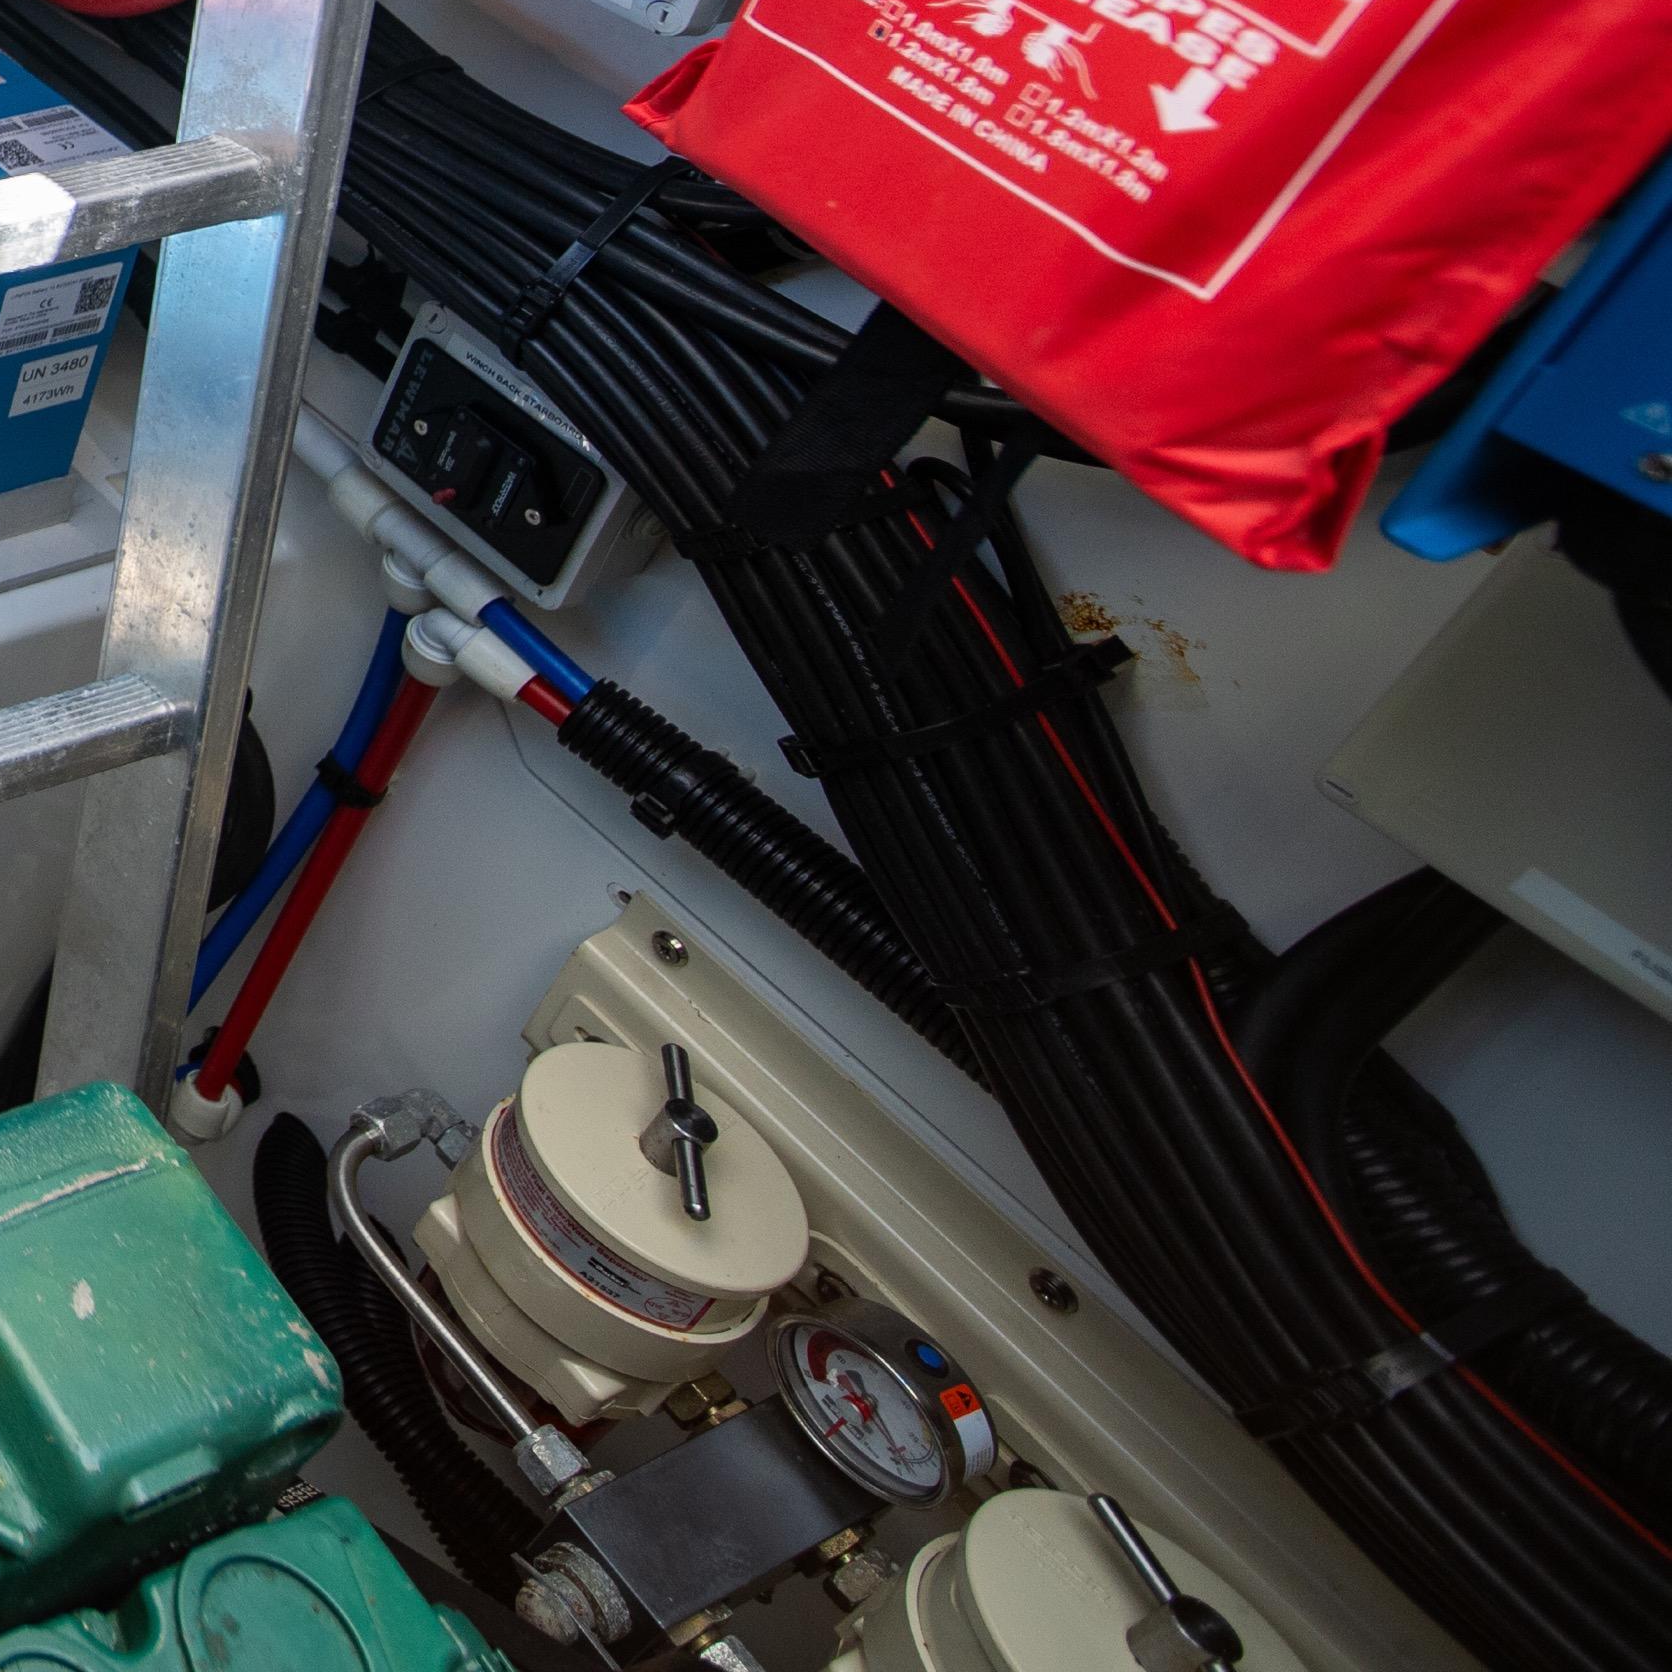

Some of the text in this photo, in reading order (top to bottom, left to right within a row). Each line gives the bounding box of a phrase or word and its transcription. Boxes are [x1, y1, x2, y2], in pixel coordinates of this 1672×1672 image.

[887, 66, 1051, 173] MADE IN CHINA
[40, 298, 53, 309] CE
[22, 355, 89, 382] UN 3480
[23, 384, 74, 406] 4173Wh
[382, 348, 434, 452] LEWMAR
[465, 351, 583, 441] WINCH BACK STARBOARD
[596, 1246, 649, 1283] Separator
